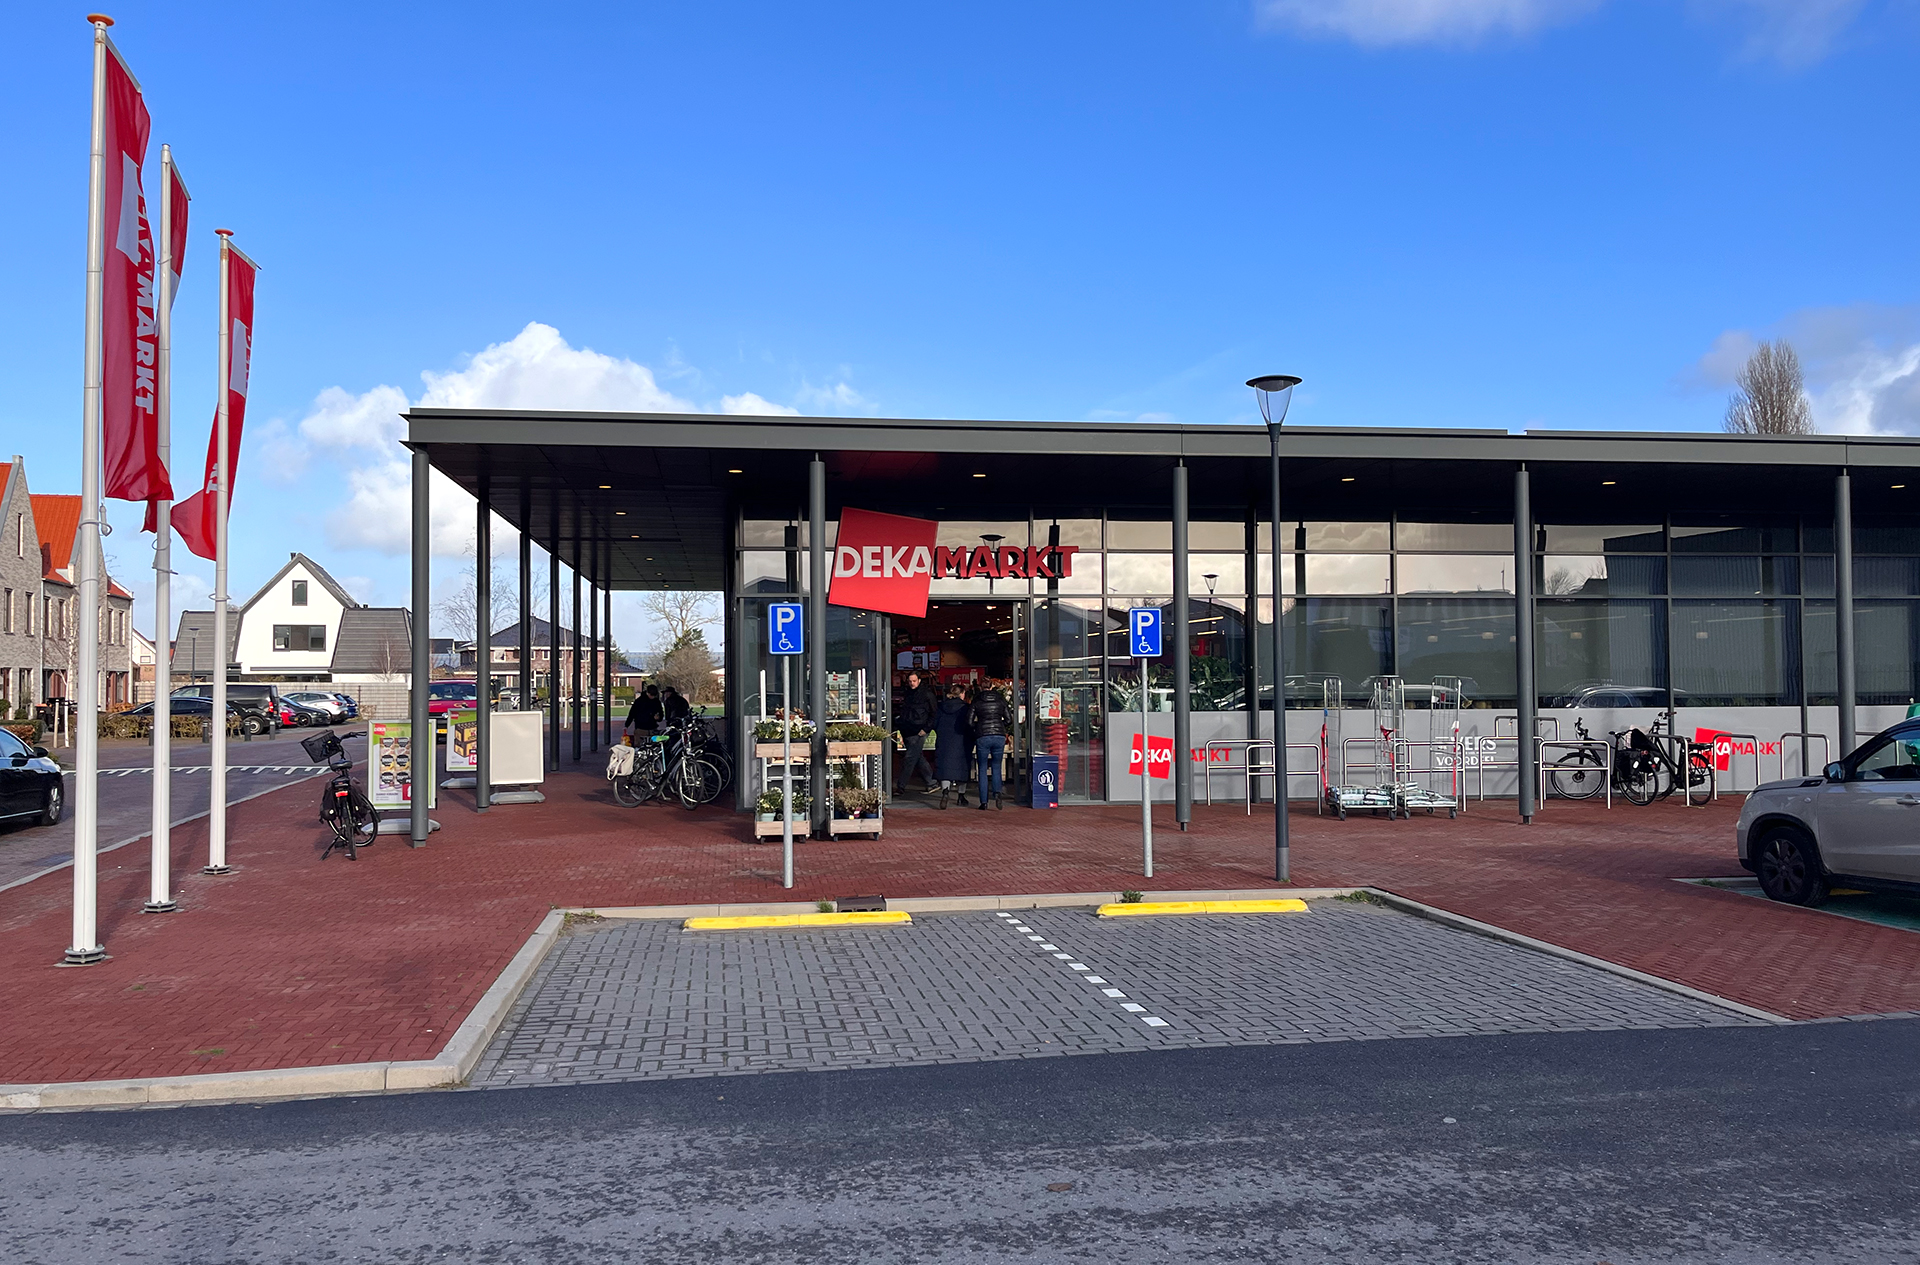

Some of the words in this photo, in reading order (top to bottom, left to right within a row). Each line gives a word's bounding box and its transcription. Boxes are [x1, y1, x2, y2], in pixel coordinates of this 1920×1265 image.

[834, 545, 1080, 578] DEKAMARKT
[776, 607, 796, 632] P
[1137, 611, 1155, 636] P
